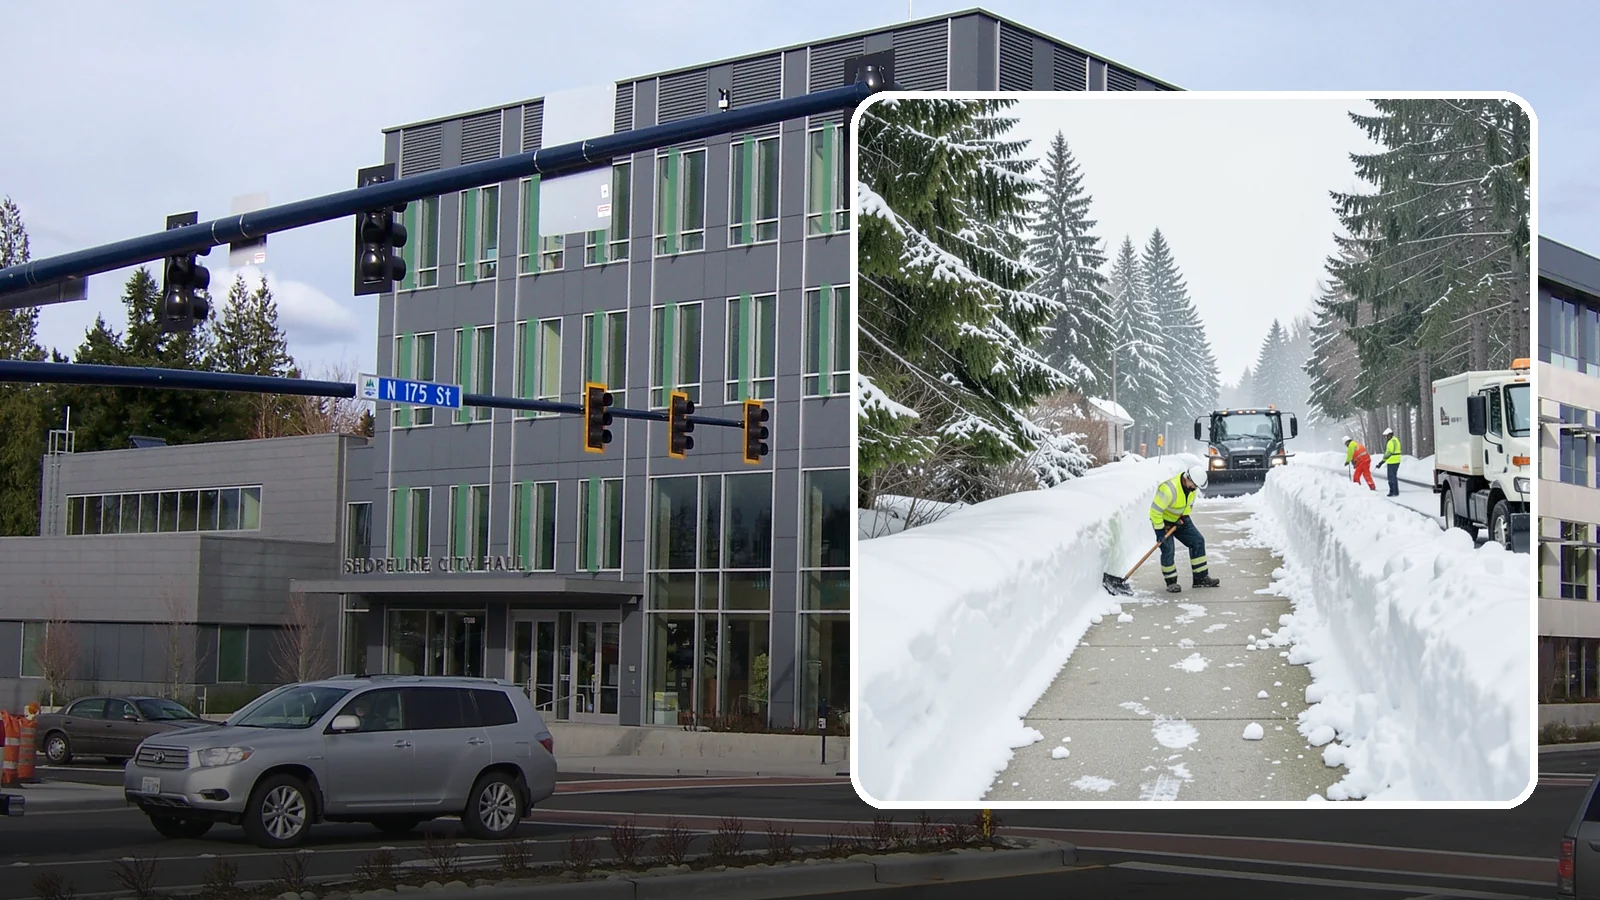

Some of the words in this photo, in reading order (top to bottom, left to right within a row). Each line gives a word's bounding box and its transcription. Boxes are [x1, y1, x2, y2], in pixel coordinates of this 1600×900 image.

[387, 380, 396, 399] N
[405, 383, 427, 403] 175
[436, 386, 451, 406] St
[344, 556, 432, 573] SHORELINE
[438, 556, 475, 572] CITY
[483, 555, 525, 571] HALL
